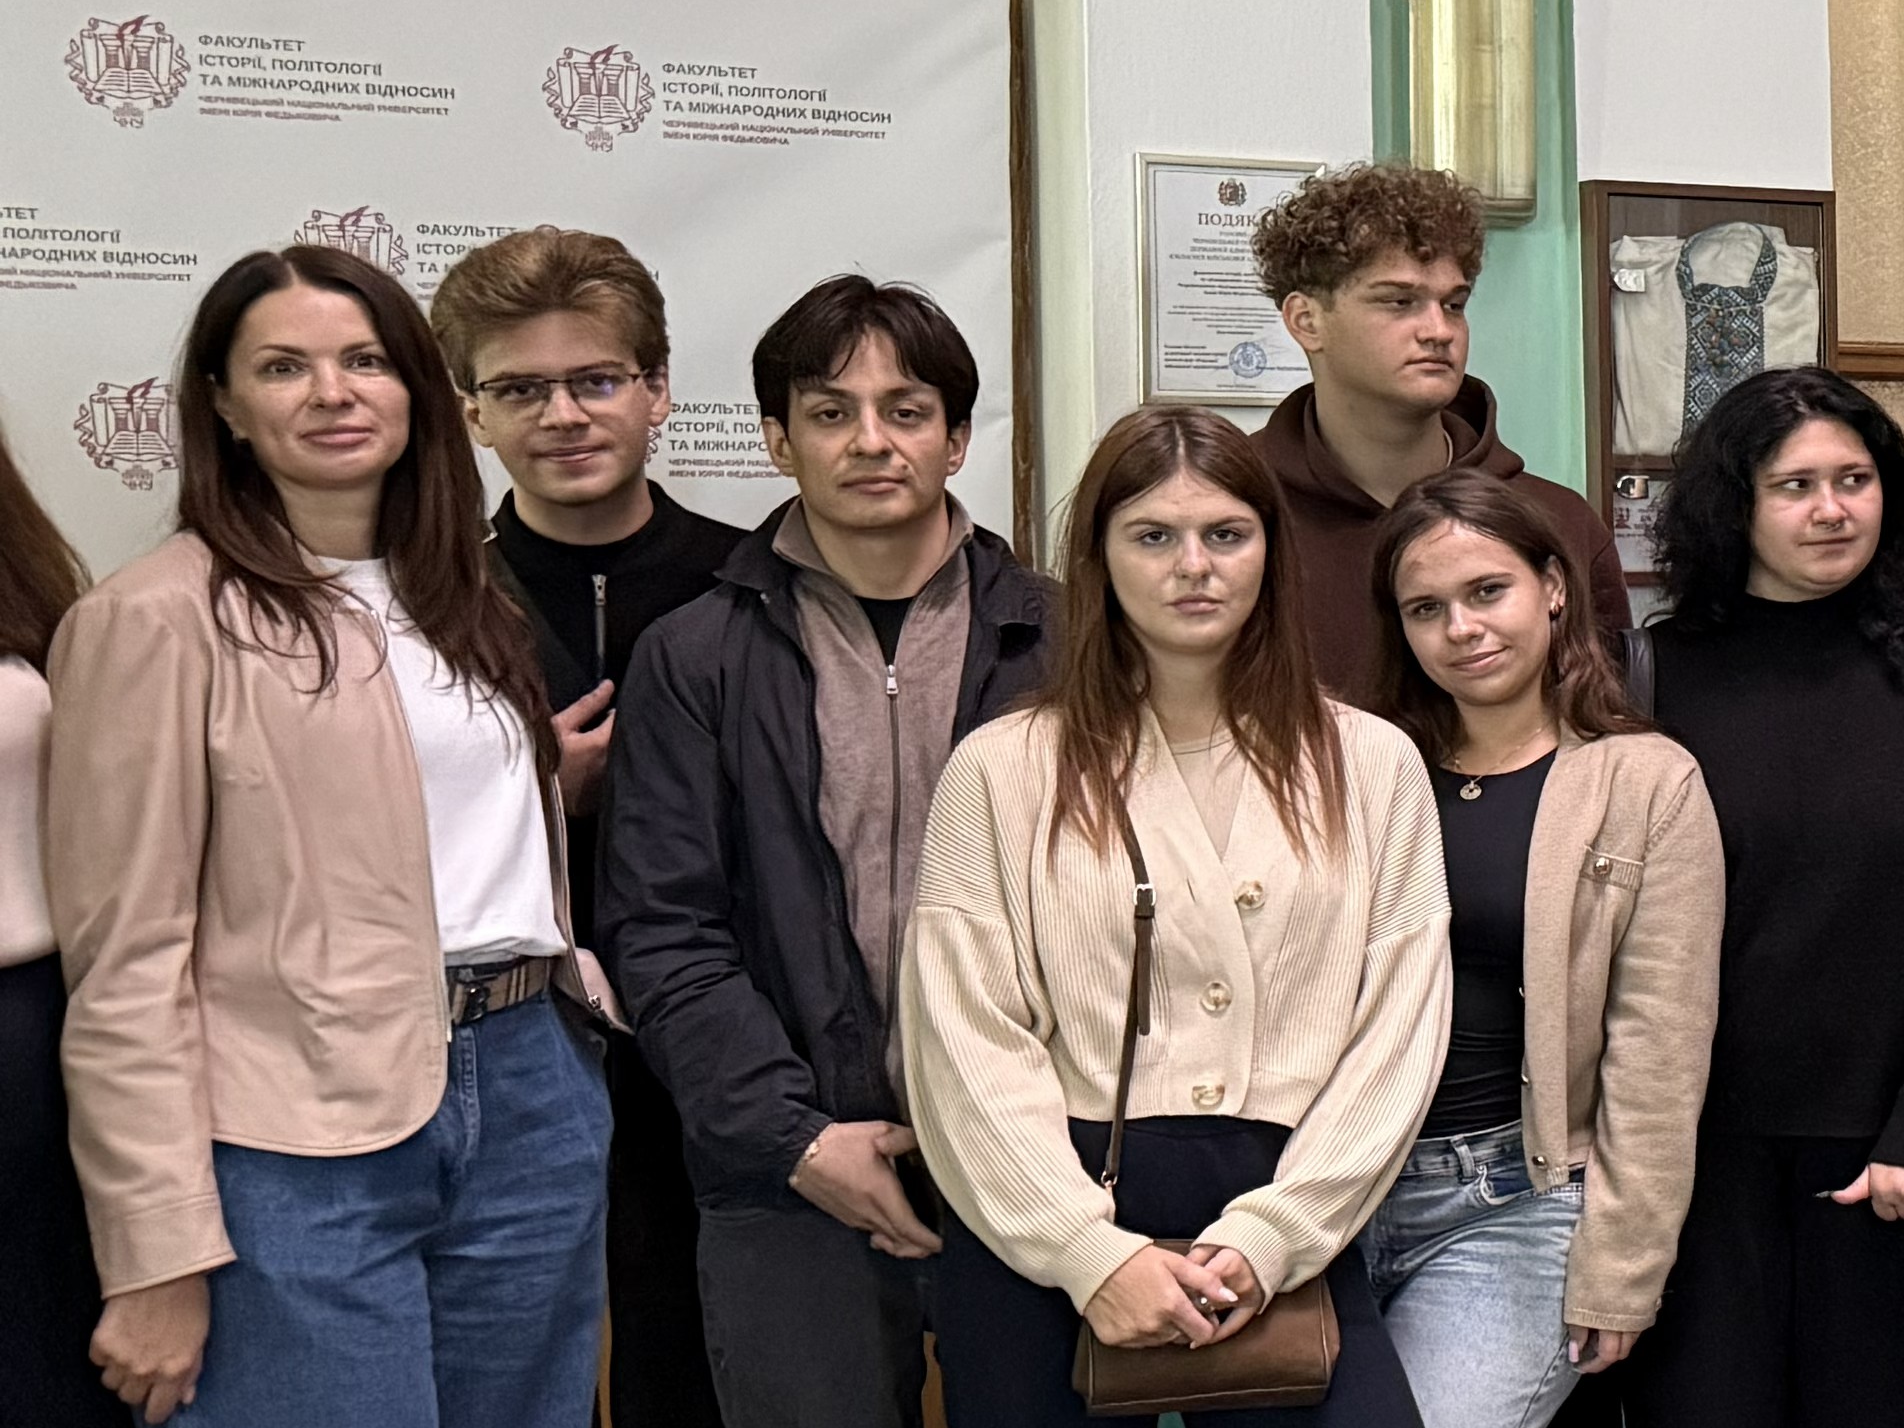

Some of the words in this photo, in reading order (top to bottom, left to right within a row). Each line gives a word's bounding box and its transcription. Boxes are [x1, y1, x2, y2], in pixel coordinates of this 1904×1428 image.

[198, 34, 306, 52] ФАКУЛЬТЕТ
[271, 58, 382, 76] ПОЛІТОЛОГІЇ
[662, 62, 758, 79] ФАКУЛЬТЕТ
[198, 73, 223, 87] ТА
[227, 75, 361, 95] МІЖНАРОДНИХ
[365, 83, 455, 99] ВІДНОСИН
[662, 81, 723, 98] ІСТОРІЇ,
[727, 84, 828, 103] ПОЛІТОЛОГІЇ
[663, 100, 684, 113] ТА
[688, 101, 807, 121] МІЖНАРОДНИХ
[811, 108, 892, 124] ВІДНОСИН
[1198, 212, 1258, 227] ПОДЯК
[2, 226, 121, 244] ПОЛІТОЛОГІЇ
[0, 246, 97, 264] АРОДНИХ
[102, 249, 198, 266] ВІДНОСИН
[416, 243, 467, 255] ІСТОР
[416, 261, 439, 274] ТА
[668, 419, 729, 435] ІСТОРІЇ,
[668, 439, 690, 452] ТА
[694, 439, 768, 452] МІЖНАРО
